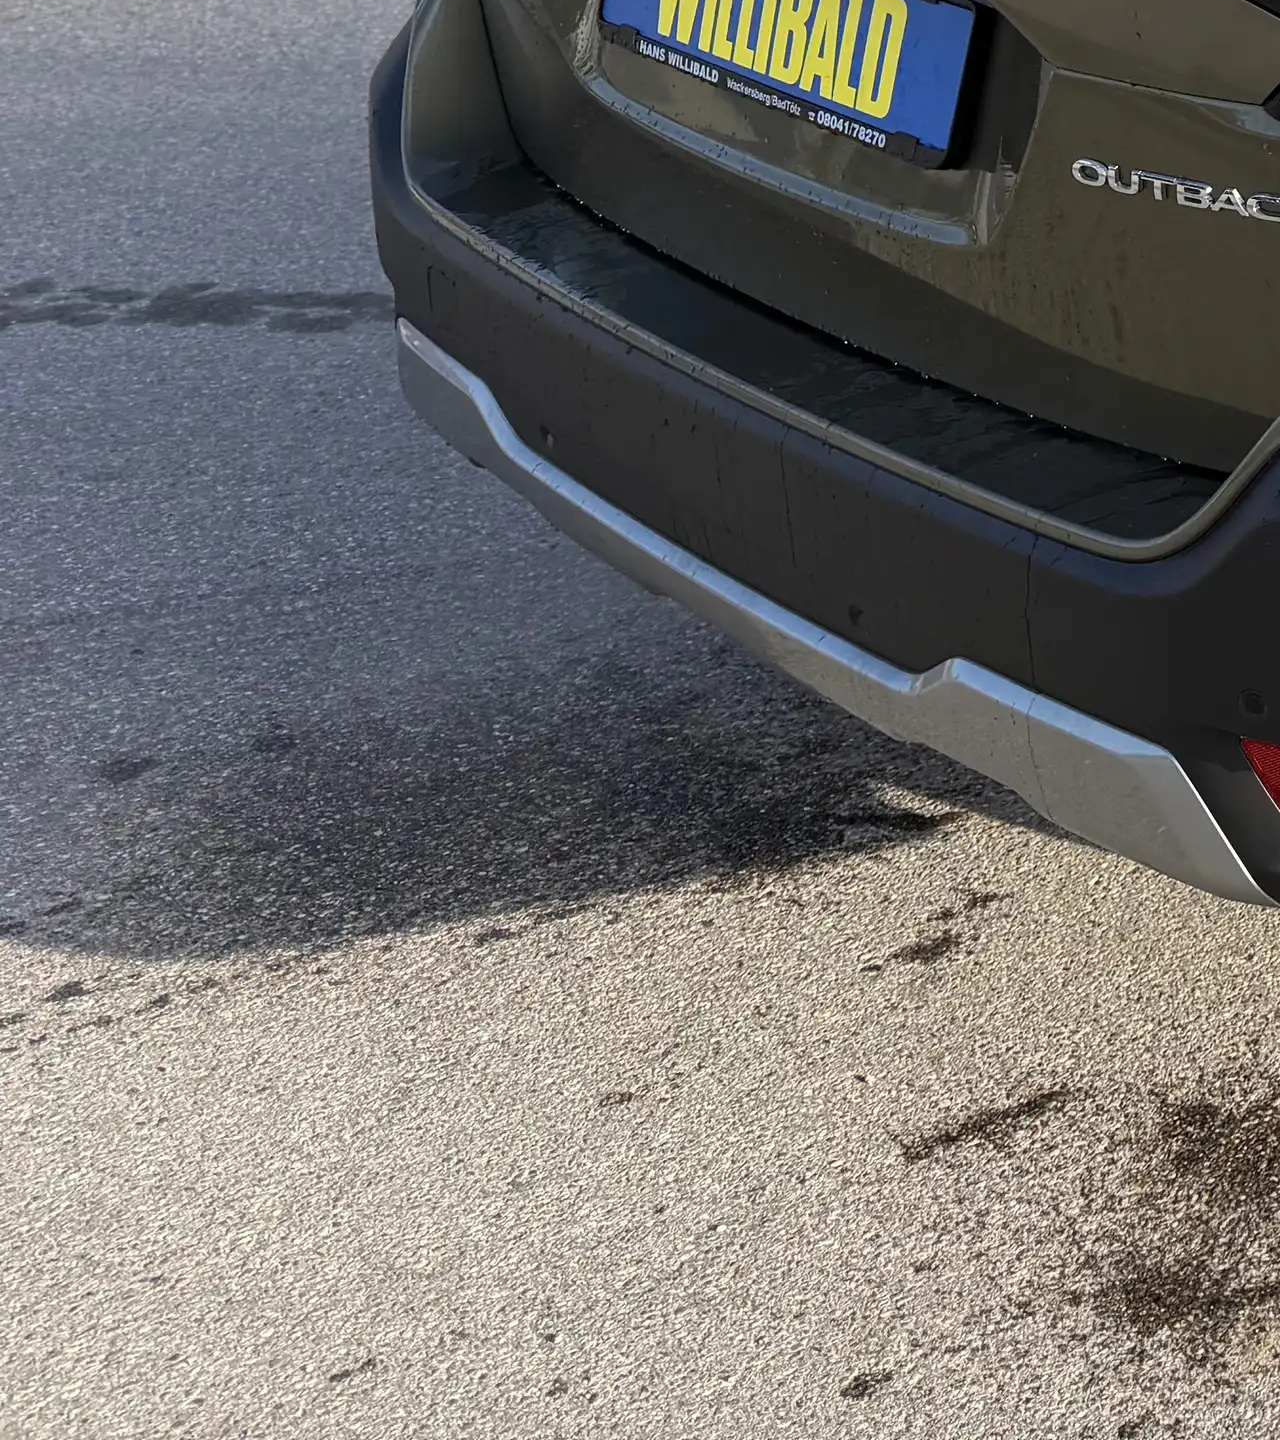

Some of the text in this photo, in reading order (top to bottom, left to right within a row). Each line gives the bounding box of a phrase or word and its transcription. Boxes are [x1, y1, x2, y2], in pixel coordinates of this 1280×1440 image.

[639, 40, 666, 62] HANS
[668, 53, 719, 83] WILLIBALD
[817, 110, 886, 148] 08041/78270
